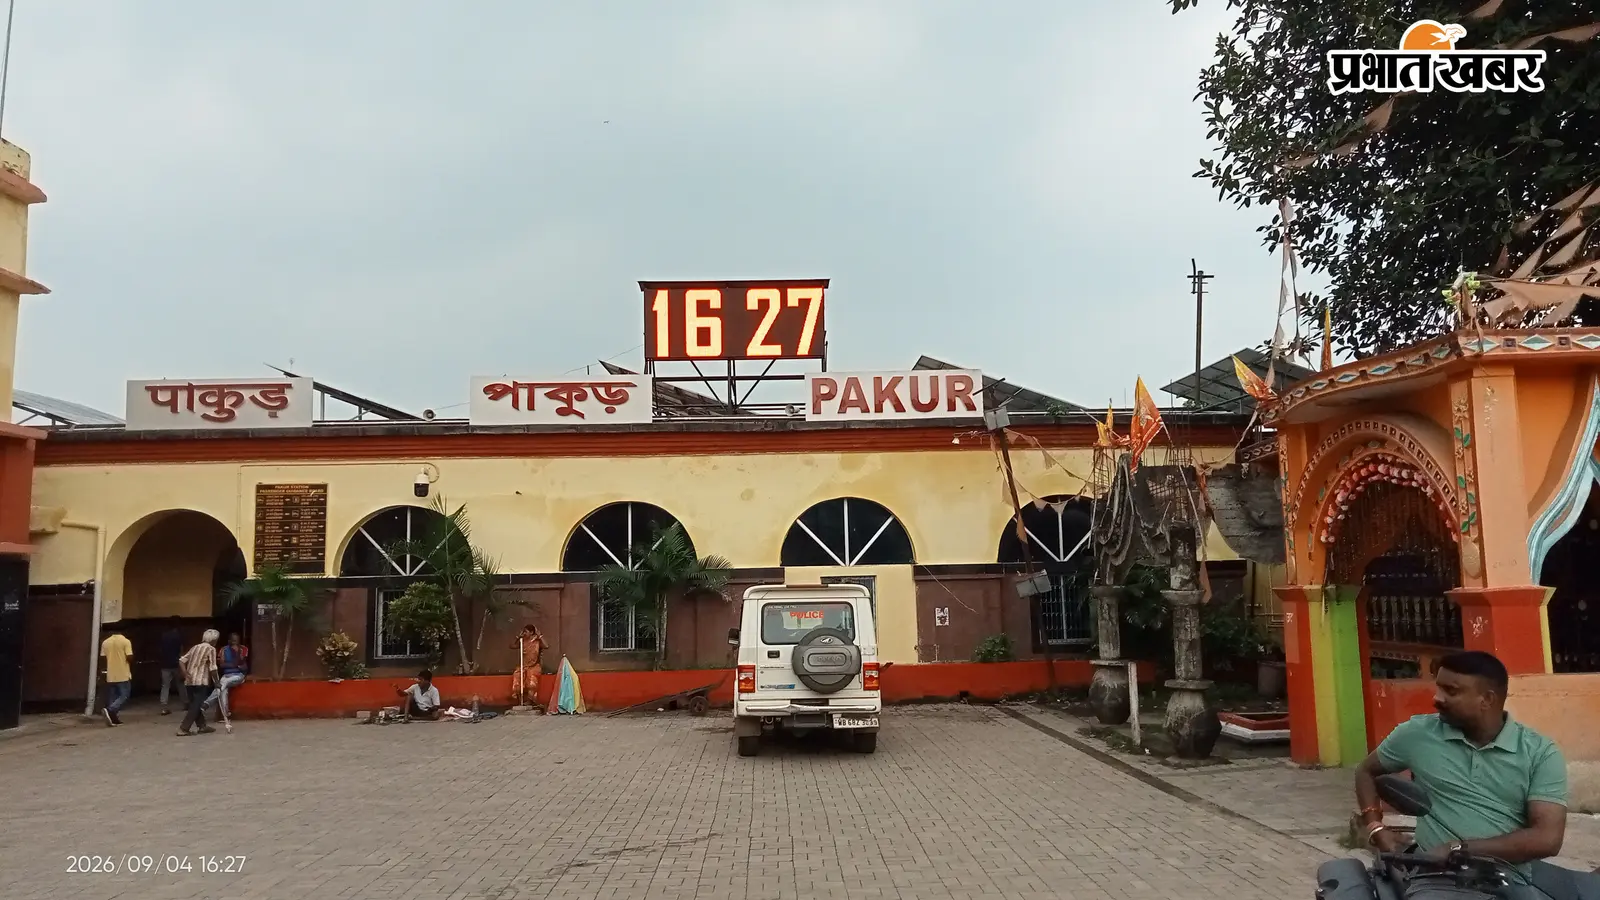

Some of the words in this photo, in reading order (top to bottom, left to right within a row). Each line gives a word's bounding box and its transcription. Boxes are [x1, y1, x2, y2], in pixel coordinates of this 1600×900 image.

[651, 288, 722, 358] 16
[745, 287, 824, 357] 27
[145, 382, 293, 422] पाकुड़
[482, 380, 637, 419] পাকুড়
[811, 374, 978, 415] PAKUR
[789, 610, 825, 619] POLICE
